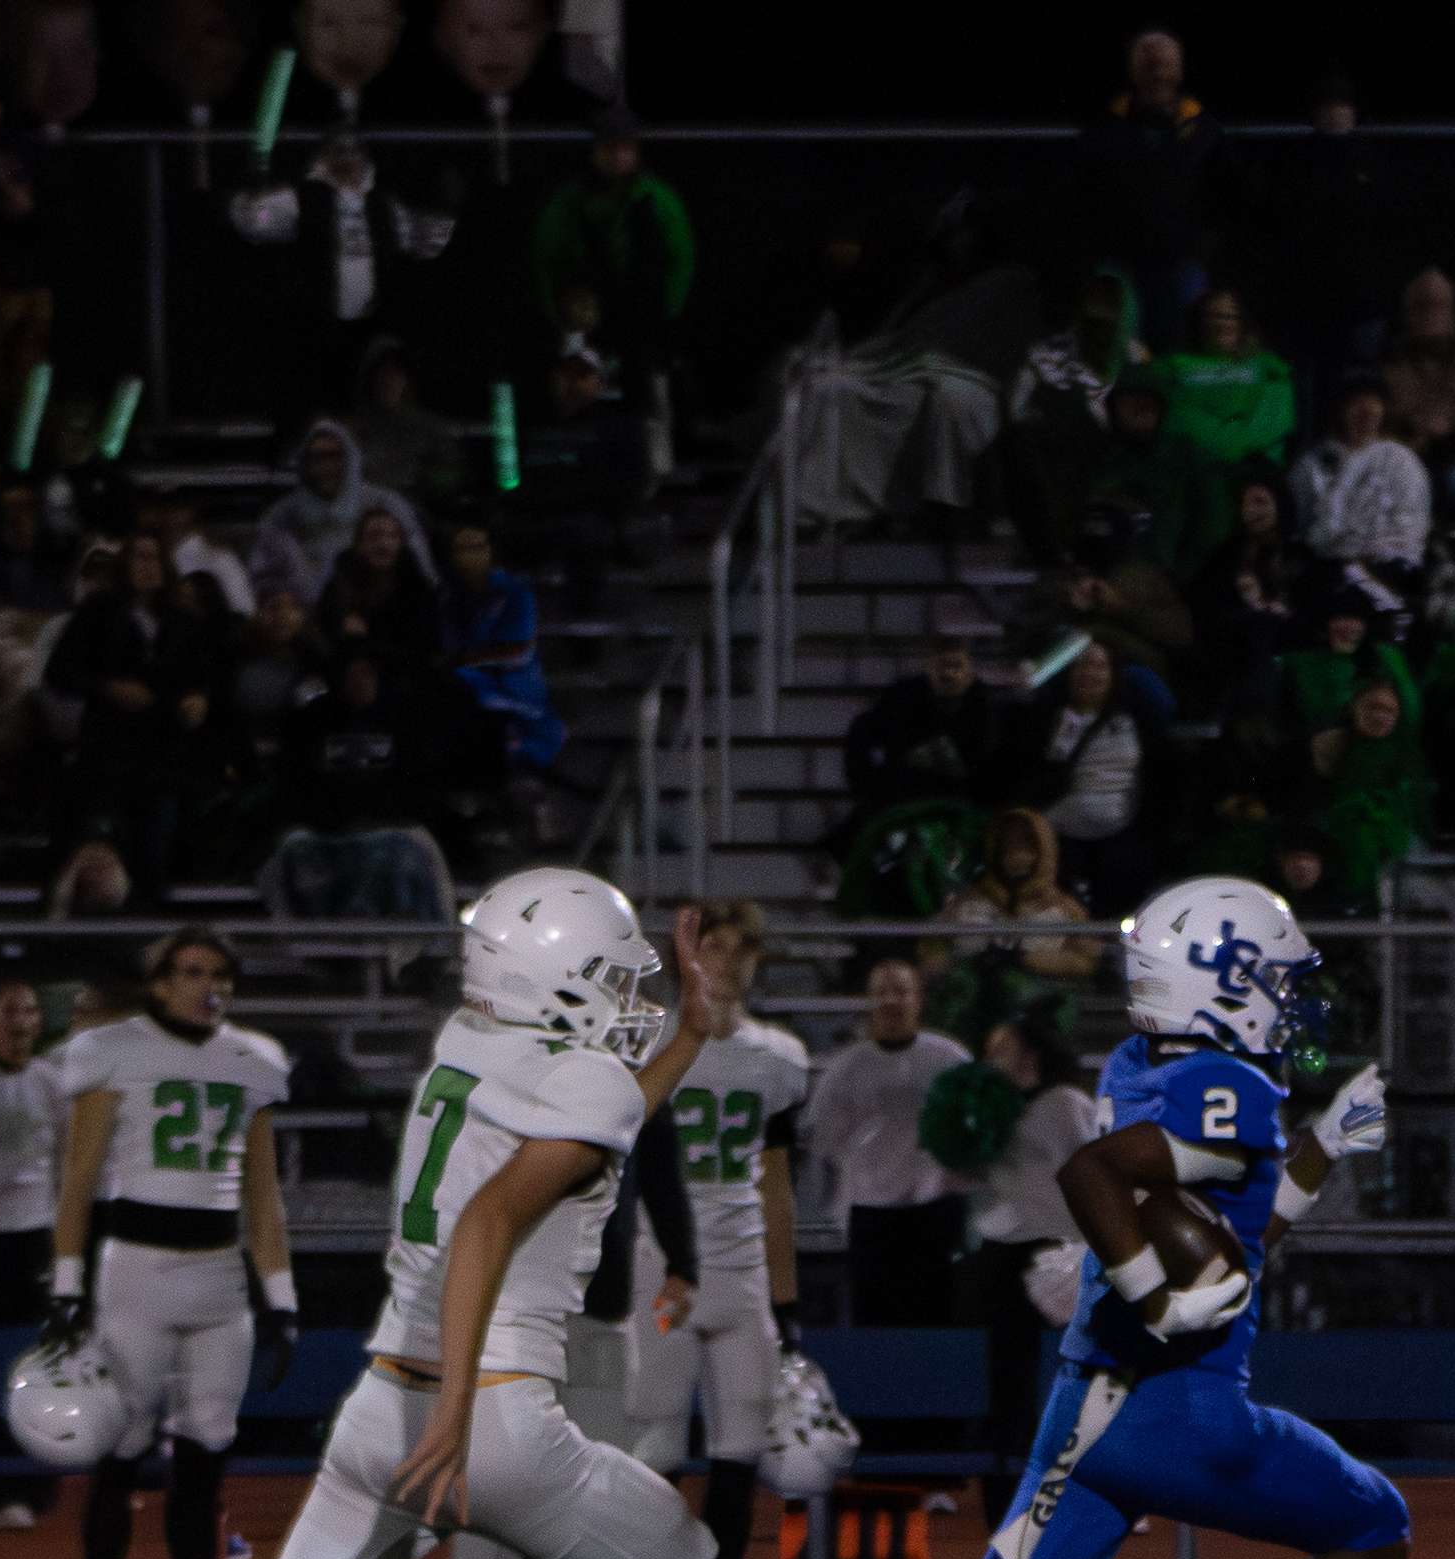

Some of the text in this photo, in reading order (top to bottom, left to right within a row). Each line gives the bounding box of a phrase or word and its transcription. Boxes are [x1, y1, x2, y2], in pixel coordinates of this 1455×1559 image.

[152, 1080, 245, 1171] 27
[400, 1063, 482, 1245] 7
[671, 1088, 763, 1183] 22
[1201, 1086, 1238, 1140] 2
